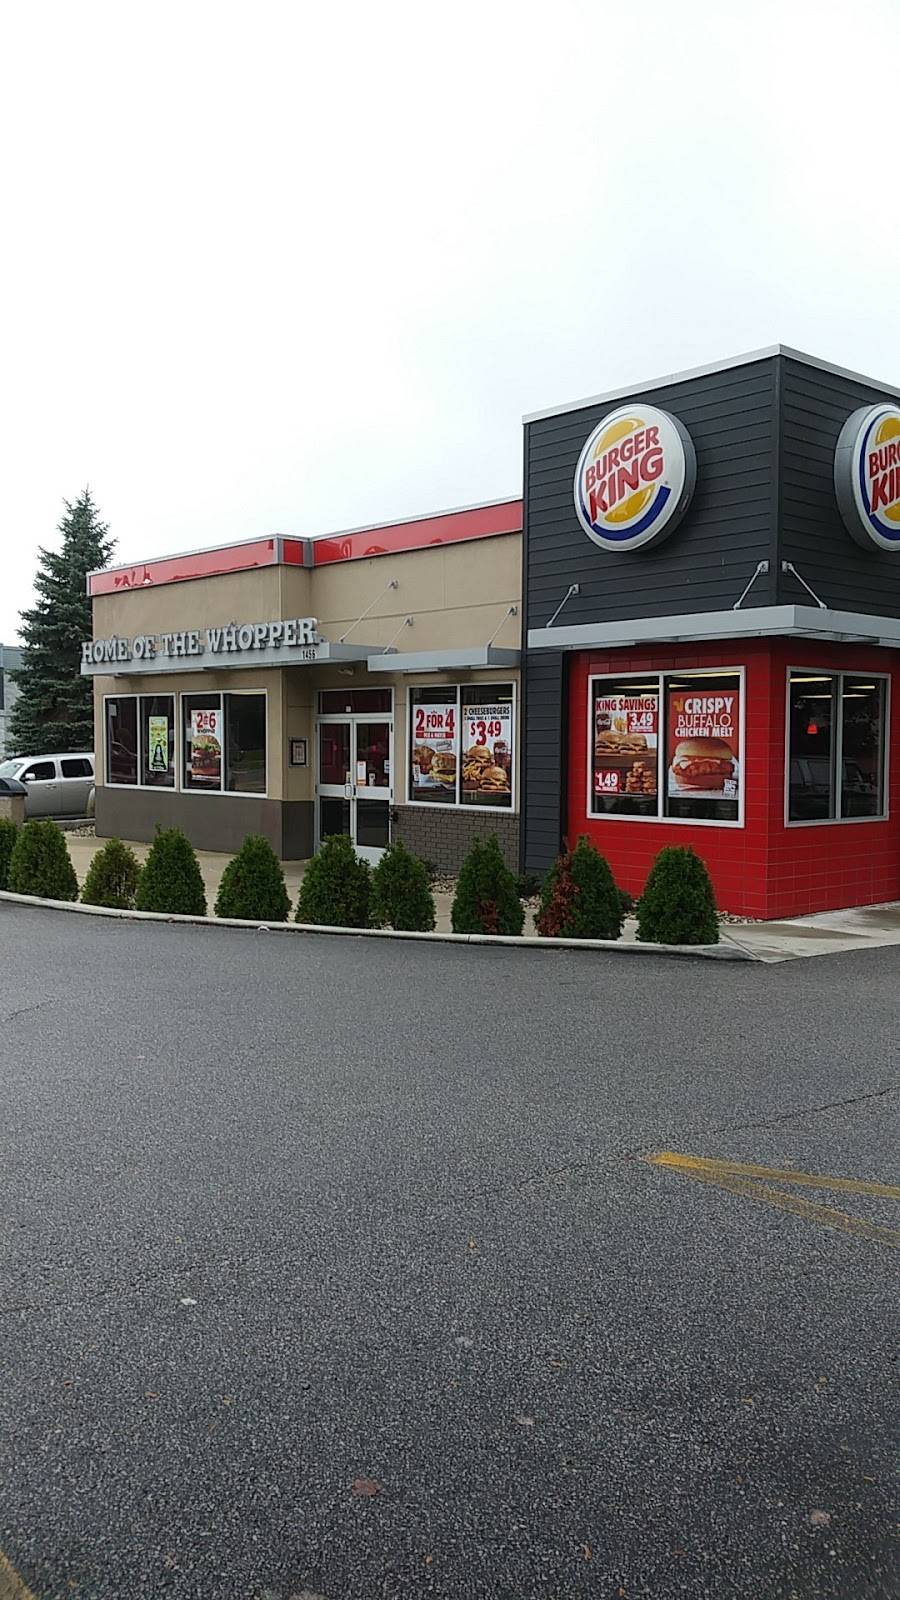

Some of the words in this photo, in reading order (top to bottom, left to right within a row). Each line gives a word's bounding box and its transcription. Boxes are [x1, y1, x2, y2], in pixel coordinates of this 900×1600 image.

[585, 426, 660, 493] BURGER
[588, 447, 664, 523] KING
[80, 638, 131, 664] HOME
[132, 635, 156, 660] OF
[160, 630, 202, 657] THE
[206, 617, 318, 653] WHOPPER
[468, 706, 510, 715] CHEESEBURGERS
[596, 699, 617, 711] KING
[684, 697, 734, 714] CRISPY
[196, 712, 204, 728] 2
[415, 709, 425, 731] 2
[426, 714, 444, 728] FOR
[678, 714, 731, 728] BUFFALO
[674, 727, 709, 737] CHICKEN
[711, 727, 734, 737] MELT
